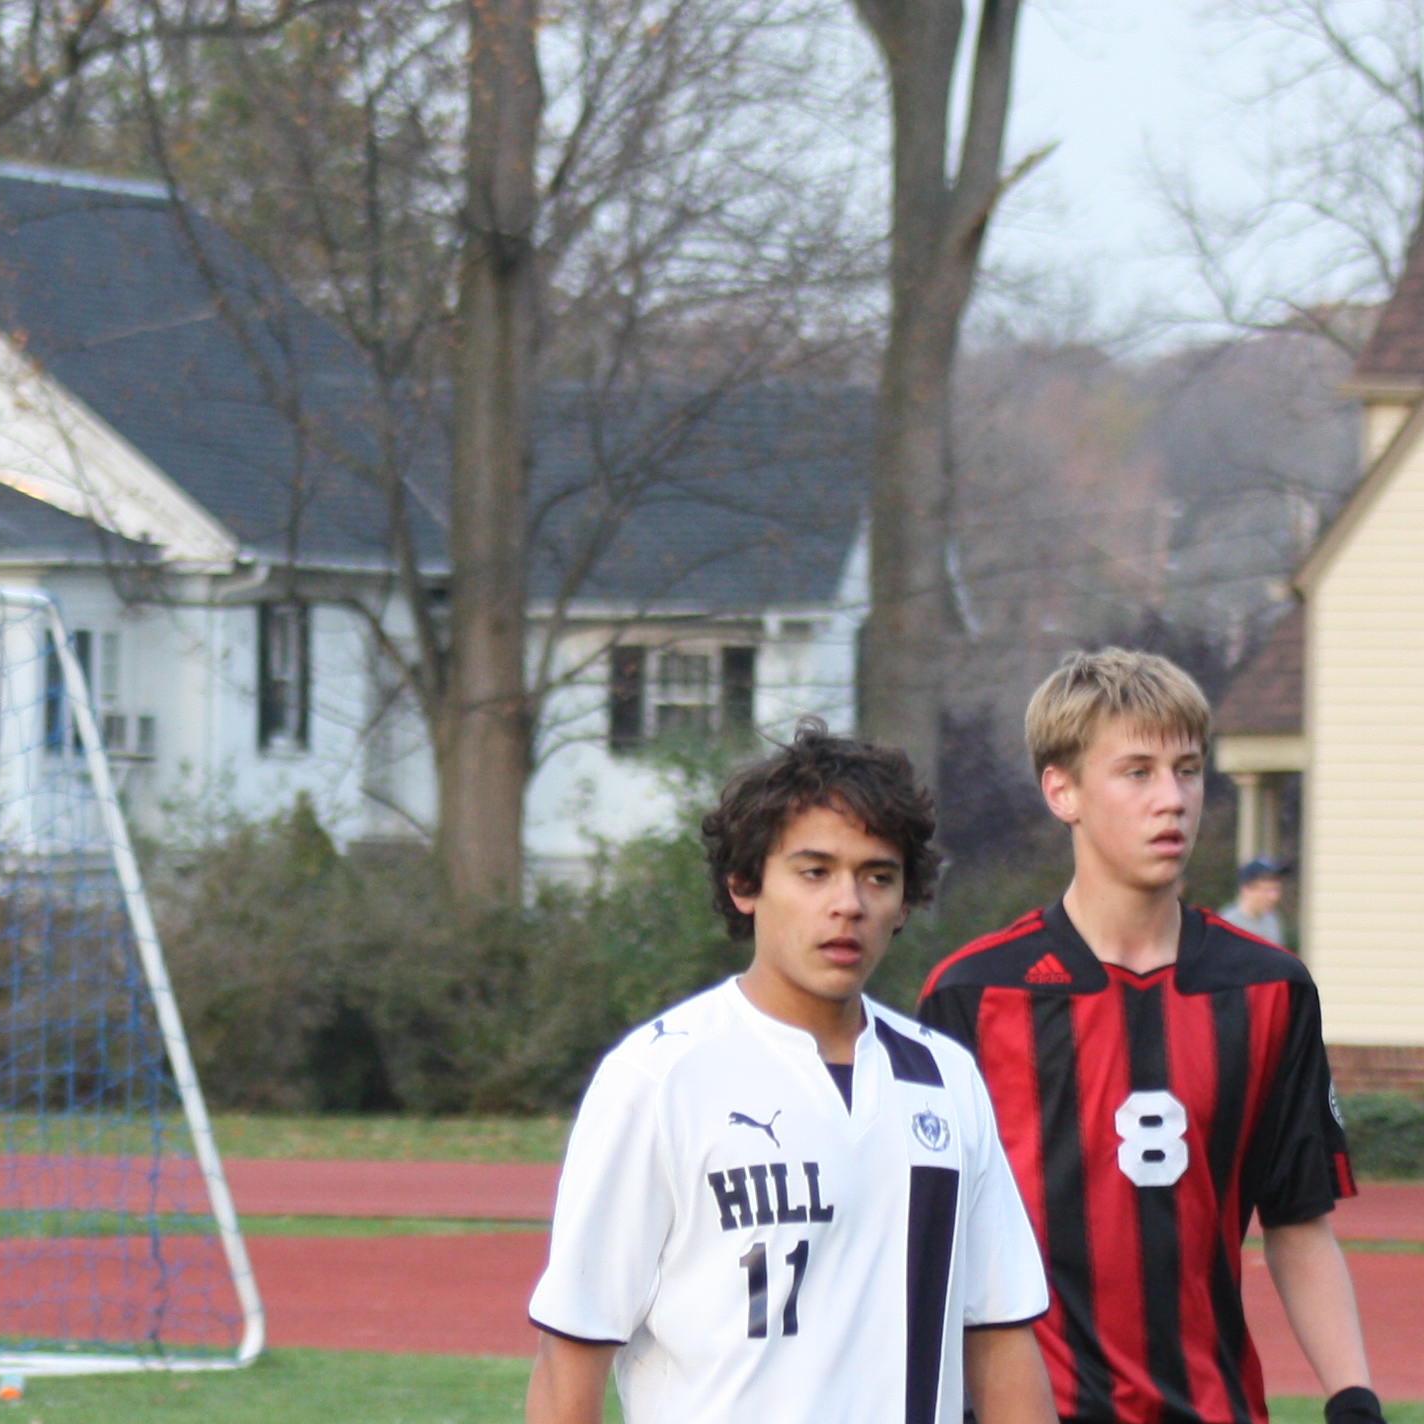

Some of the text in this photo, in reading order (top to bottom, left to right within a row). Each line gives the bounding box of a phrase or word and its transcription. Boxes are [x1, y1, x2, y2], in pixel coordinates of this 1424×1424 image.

[1114, 1090, 1189, 1187] 8
[707, 1162, 834, 1232] HILL
[739, 1239, 809, 1339] 11
